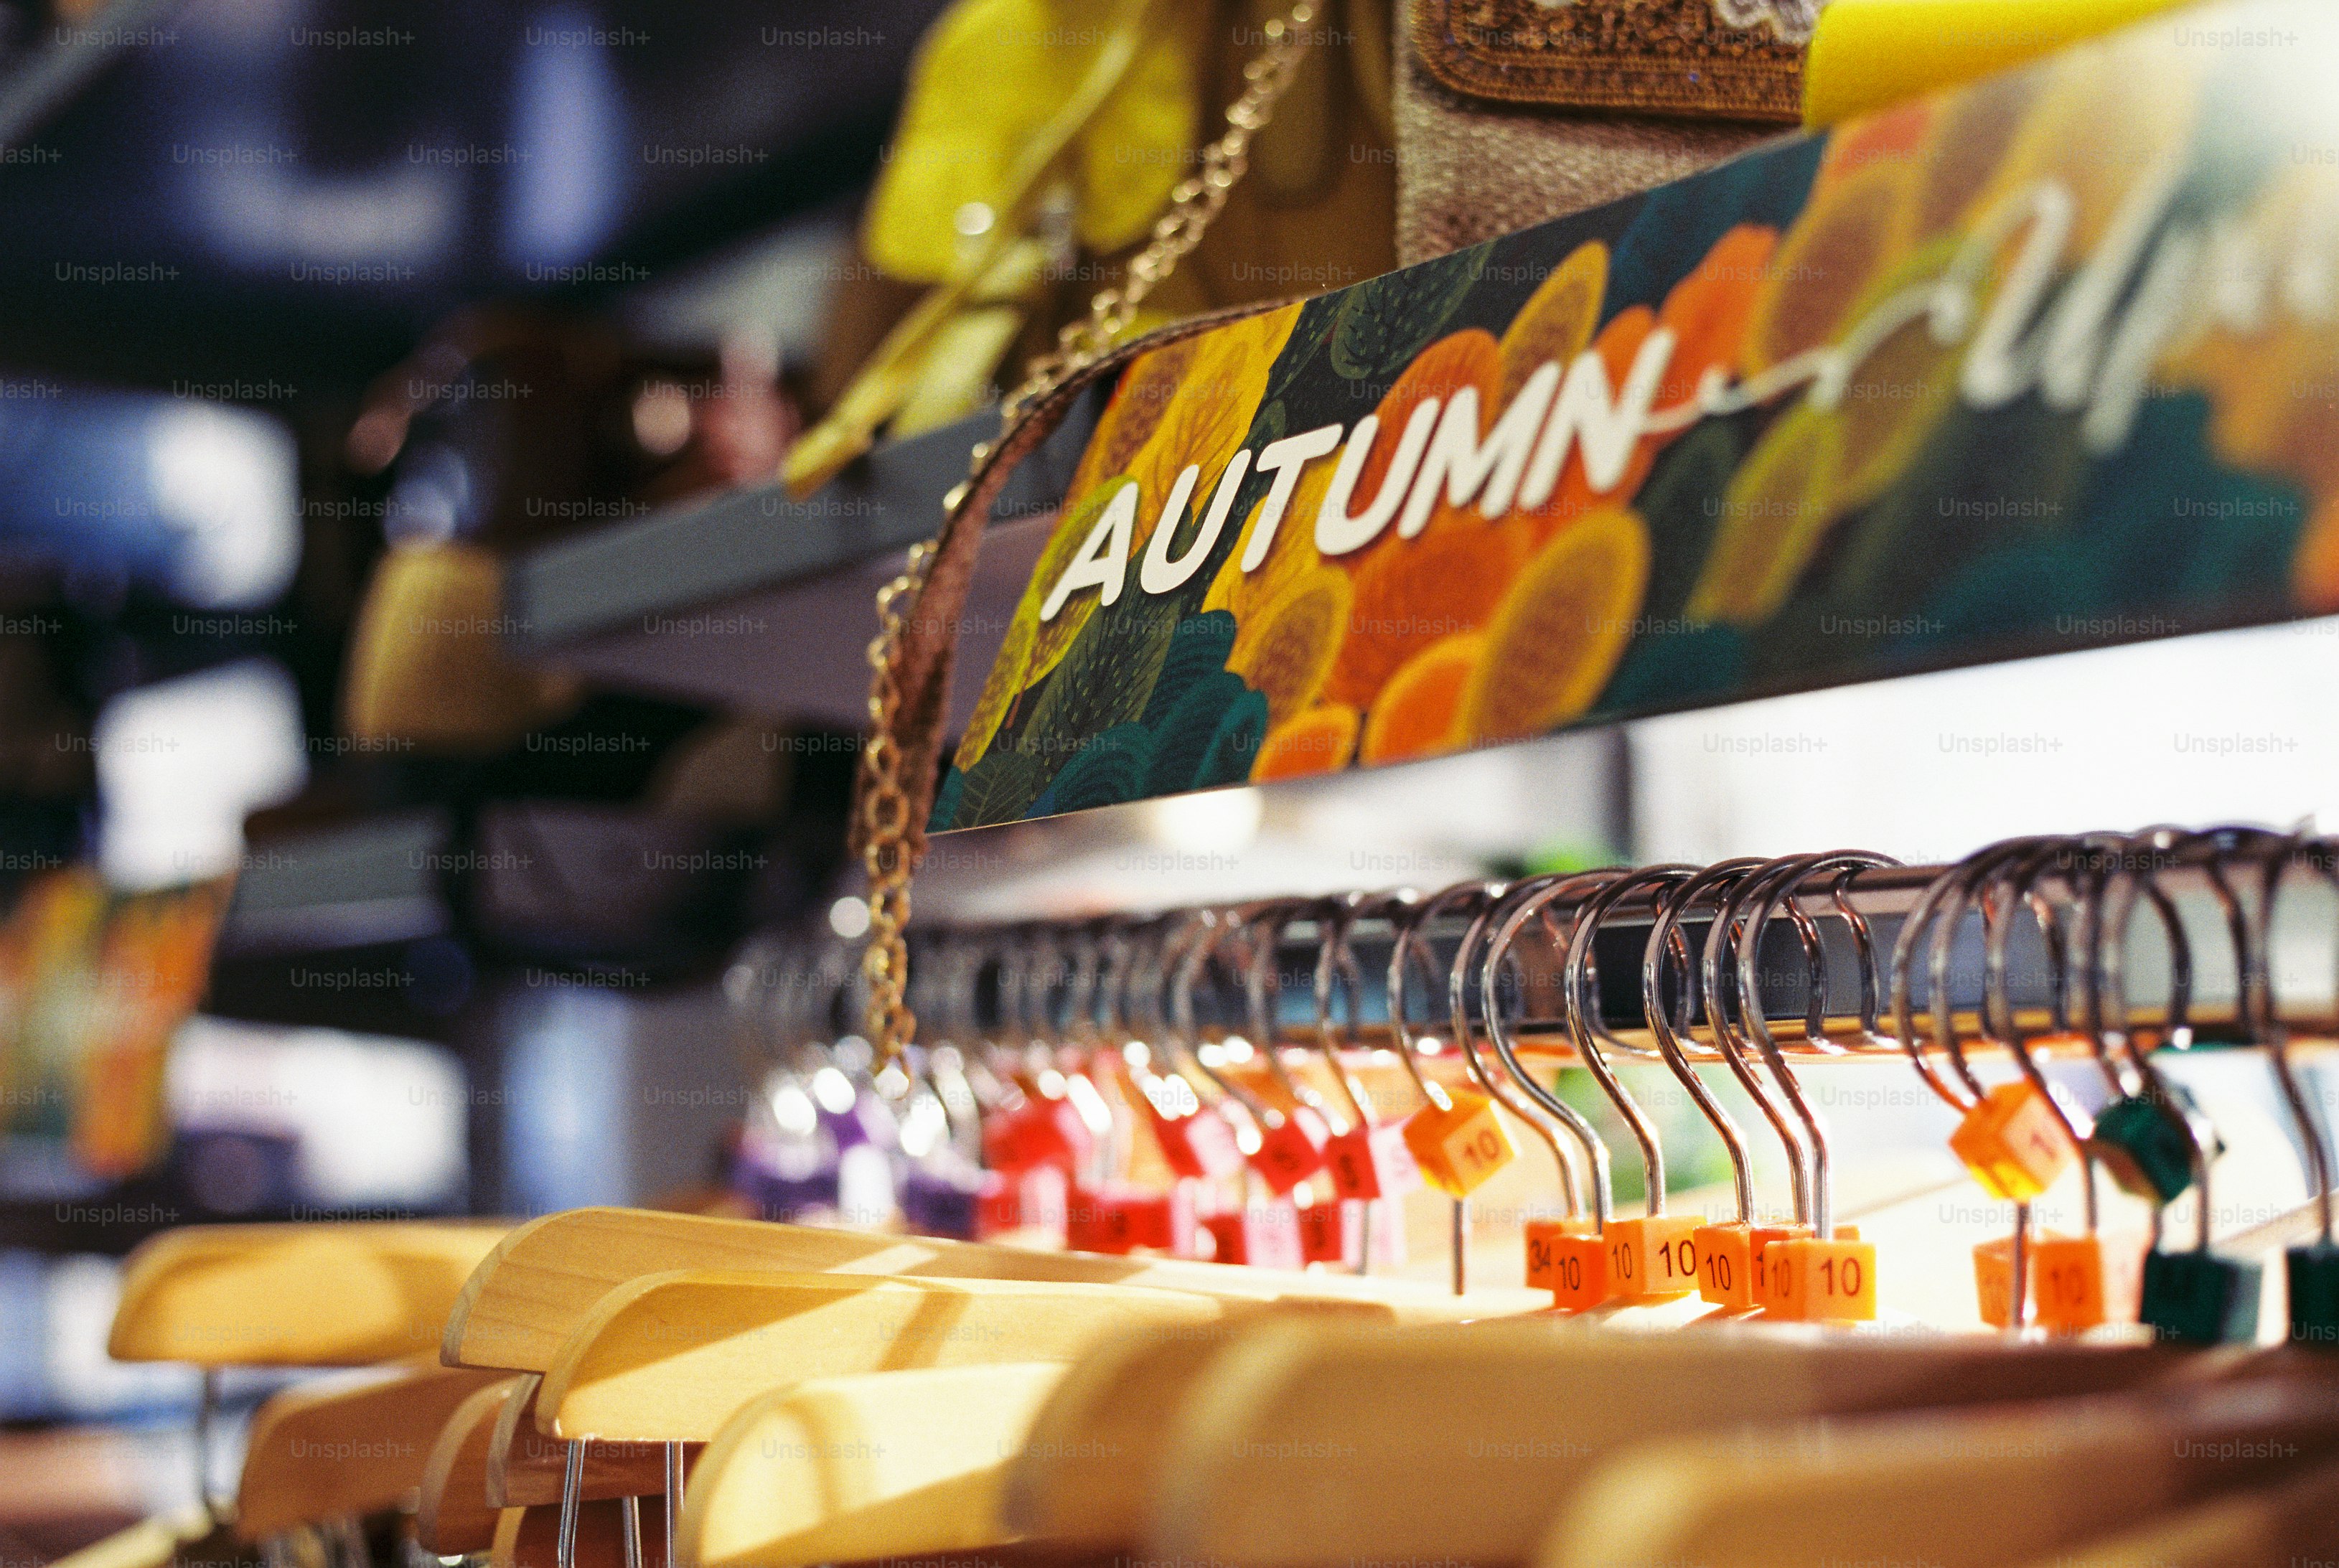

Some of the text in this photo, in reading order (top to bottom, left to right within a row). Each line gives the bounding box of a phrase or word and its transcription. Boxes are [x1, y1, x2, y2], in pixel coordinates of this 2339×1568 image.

[1039, 327, 1677, 621] AUTUMN
[1463, 1129, 1500, 1170] 10
[1558, 1256, 1581, 1291] 10
[1612, 1242, 1633, 1279] 10
[1659, 1239, 1697, 1278] 10
[1706, 1253, 1731, 1291] 10
[1820, 1257, 1861, 1297] 10
[1771, 1259, 1791, 1297] 10
